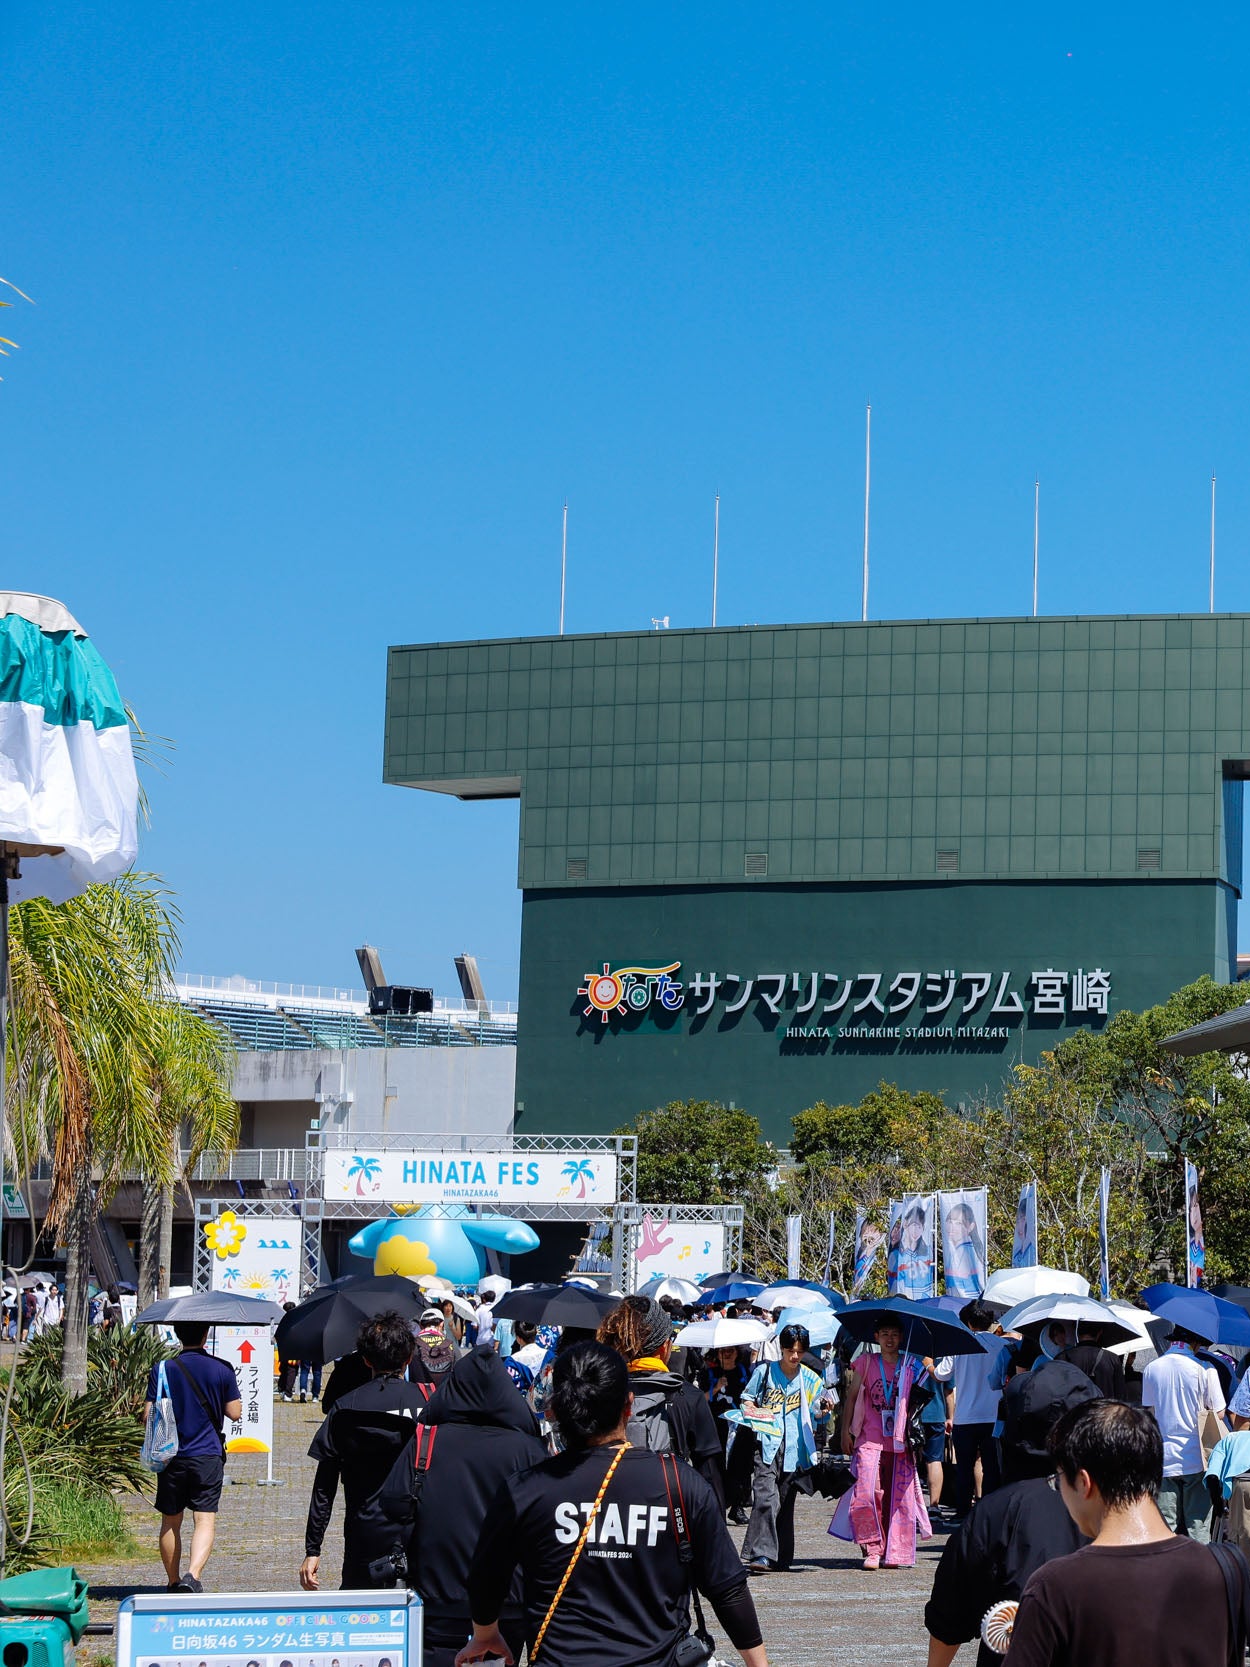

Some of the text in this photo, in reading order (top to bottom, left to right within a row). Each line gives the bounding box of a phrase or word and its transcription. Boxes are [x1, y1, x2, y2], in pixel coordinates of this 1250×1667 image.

[689, 968, 1112, 1014] サンマリンスタジアム宮崎
[786, 1027, 1009, 1038] HINATA SUNMARINE STADIUM MIYAZAKI
[402, 1160, 540, 1185] HINATA FES
[443, 1188, 499, 1198] HINATAZAKA46
[248, 1366, 259, 1424] ライブ会場
[555, 1502, 668, 1546] STAFF
[178, 1616, 268, 1628] HINATAZAKA46
[276, 1614, 336, 1627] OFFICIAL
[340, 1613, 386, 1625] GOODS
[172, 1635, 237, 1650] 日向坂46
[242, 1632, 346, 1649] ランダム生写真
